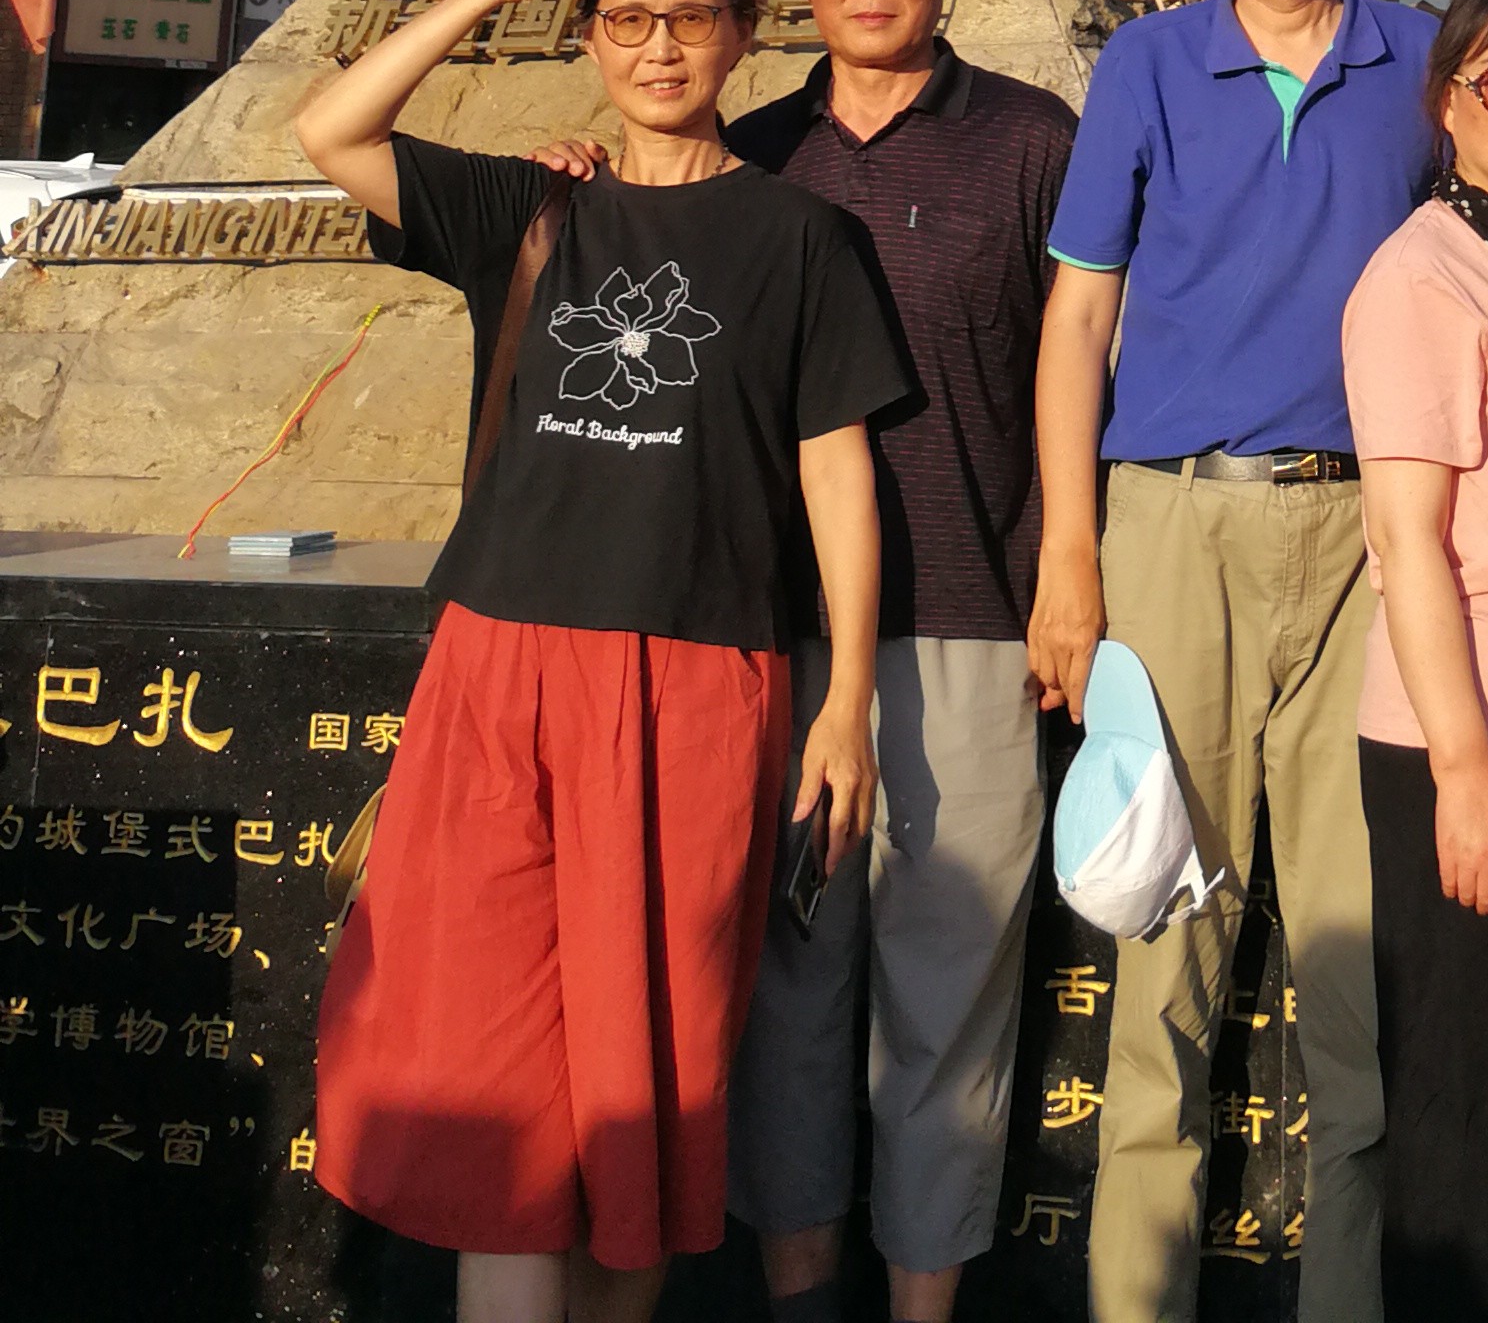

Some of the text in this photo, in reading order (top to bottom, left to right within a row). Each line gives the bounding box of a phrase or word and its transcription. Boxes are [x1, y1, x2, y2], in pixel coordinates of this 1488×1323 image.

[536, 413, 684, 450] Floral Background
[0, 666, 234, 753] 巴扎
